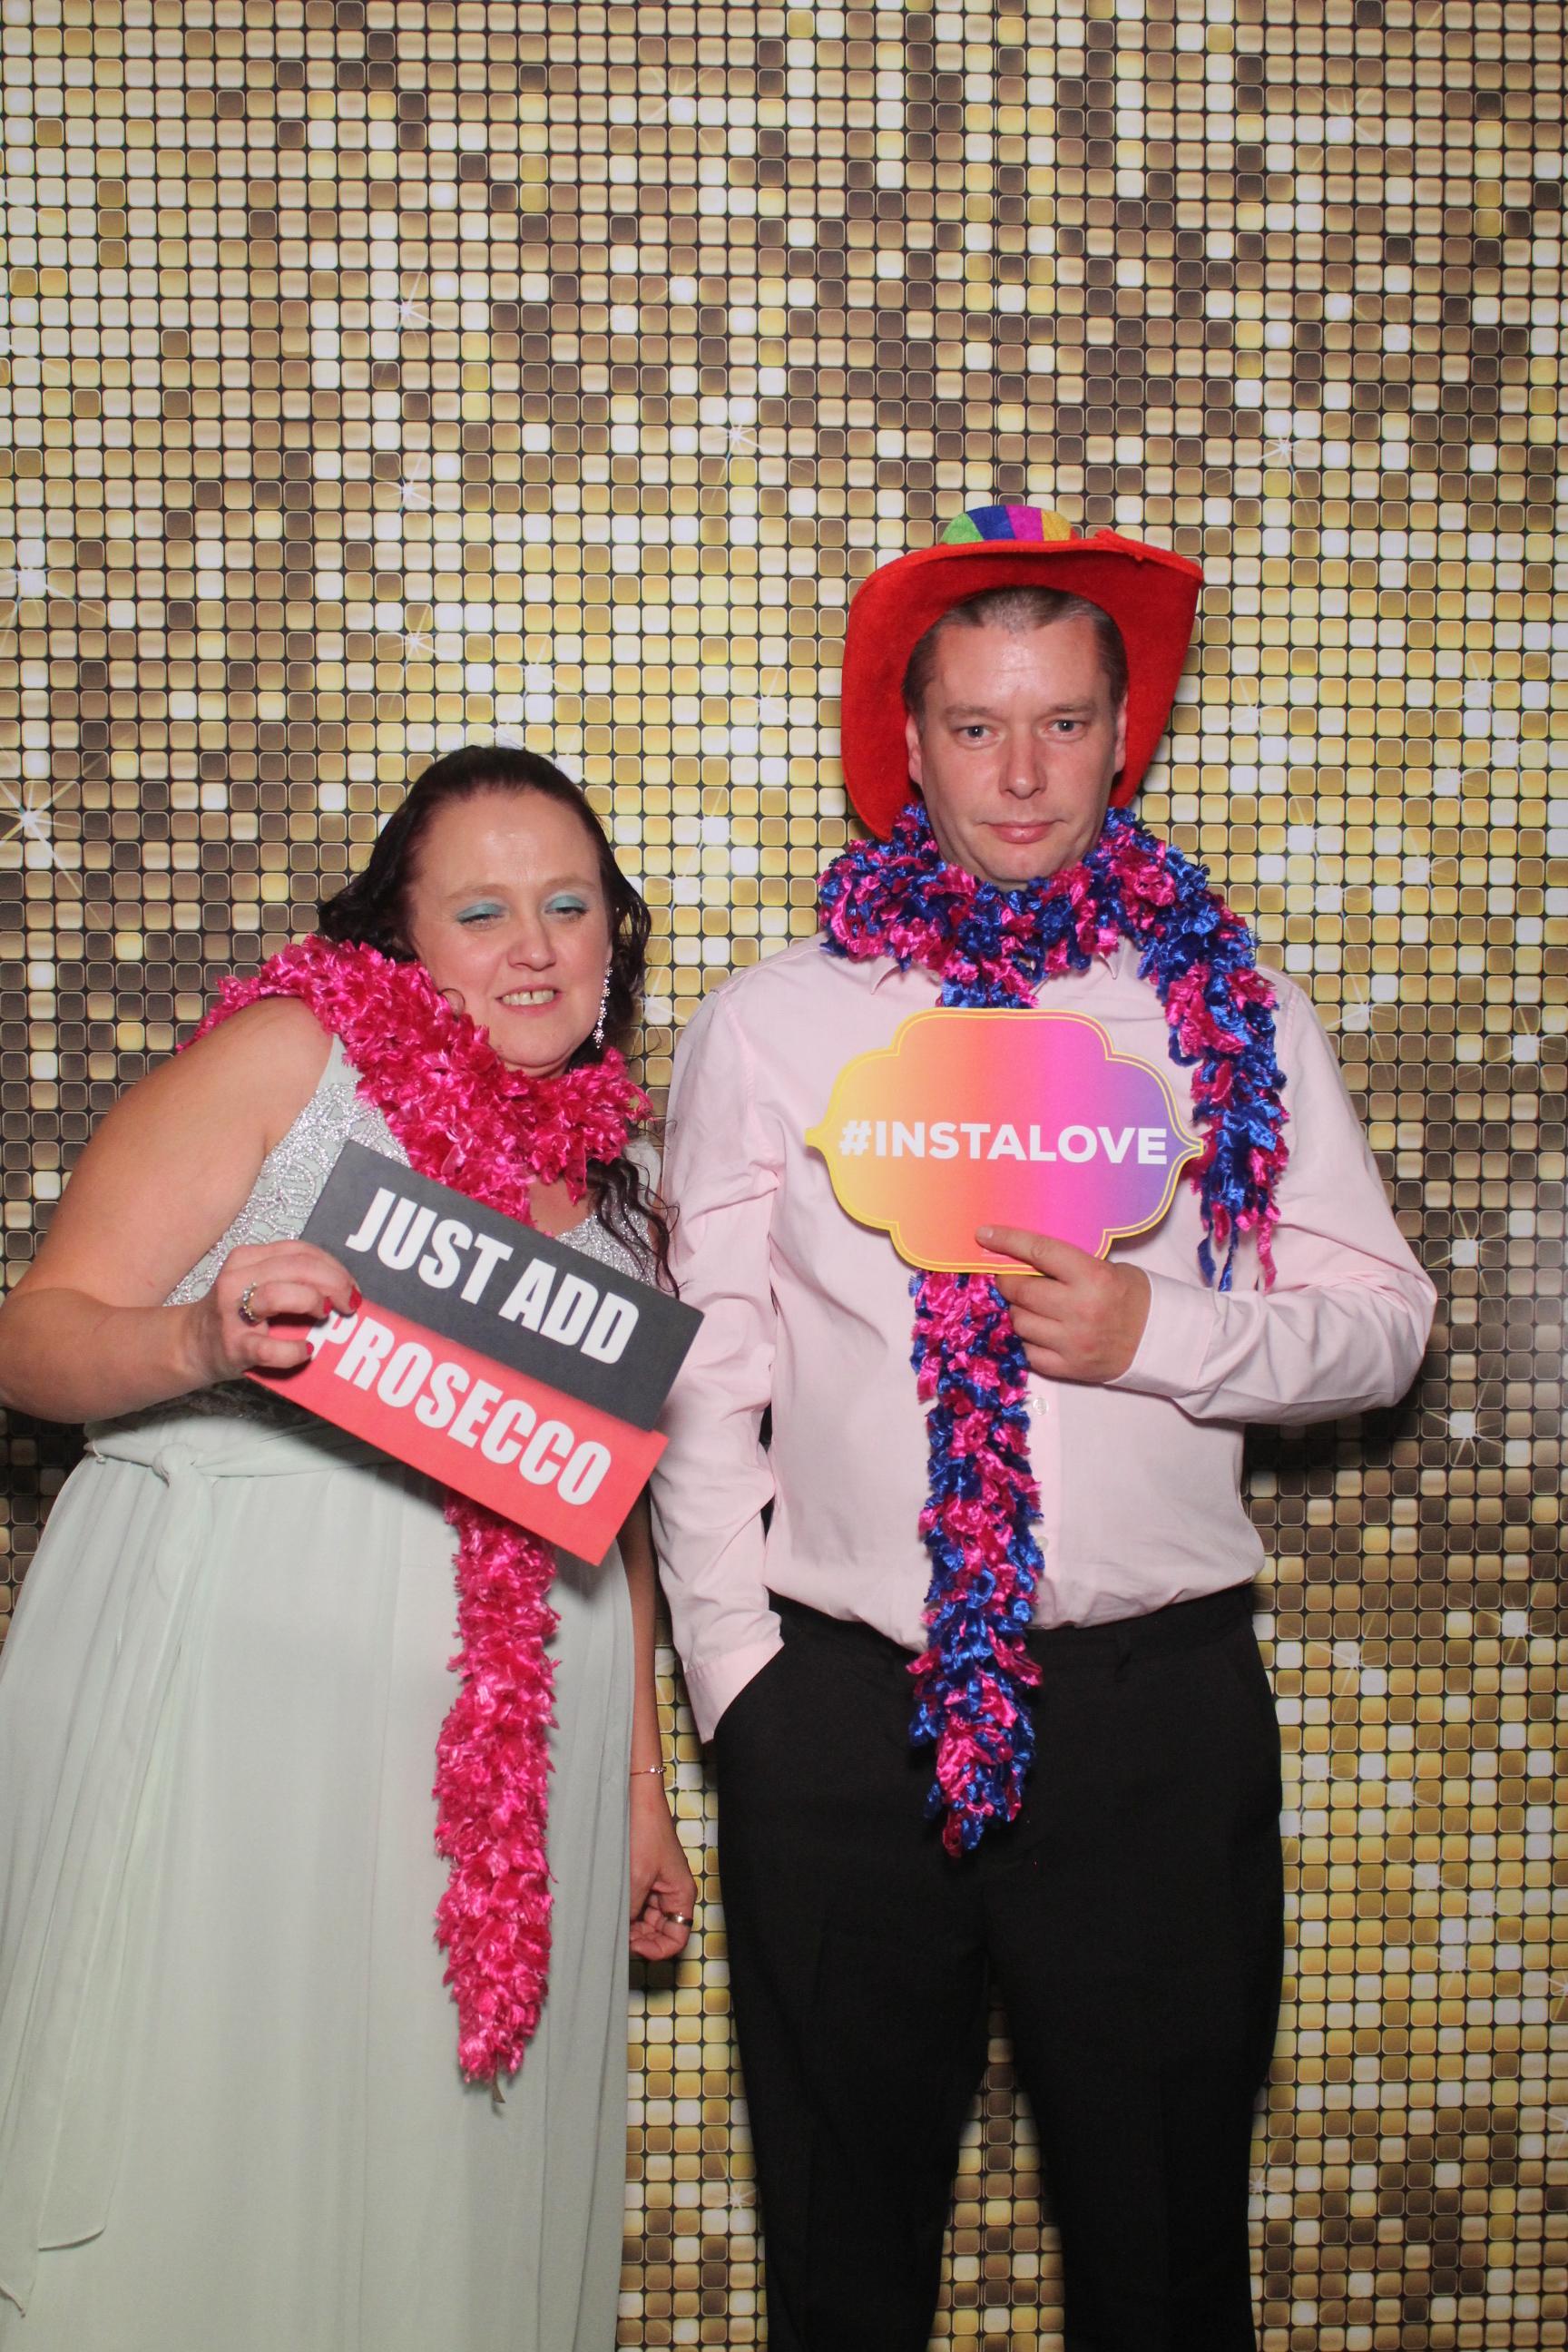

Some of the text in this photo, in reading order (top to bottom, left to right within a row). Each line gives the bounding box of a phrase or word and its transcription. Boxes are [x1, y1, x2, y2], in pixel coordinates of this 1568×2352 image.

[838, 1121, 1168, 1165] #INSTALOVE
[345, 1187, 640, 1364] JUST ADD
[305, 1309, 612, 1505] PROSECCO
